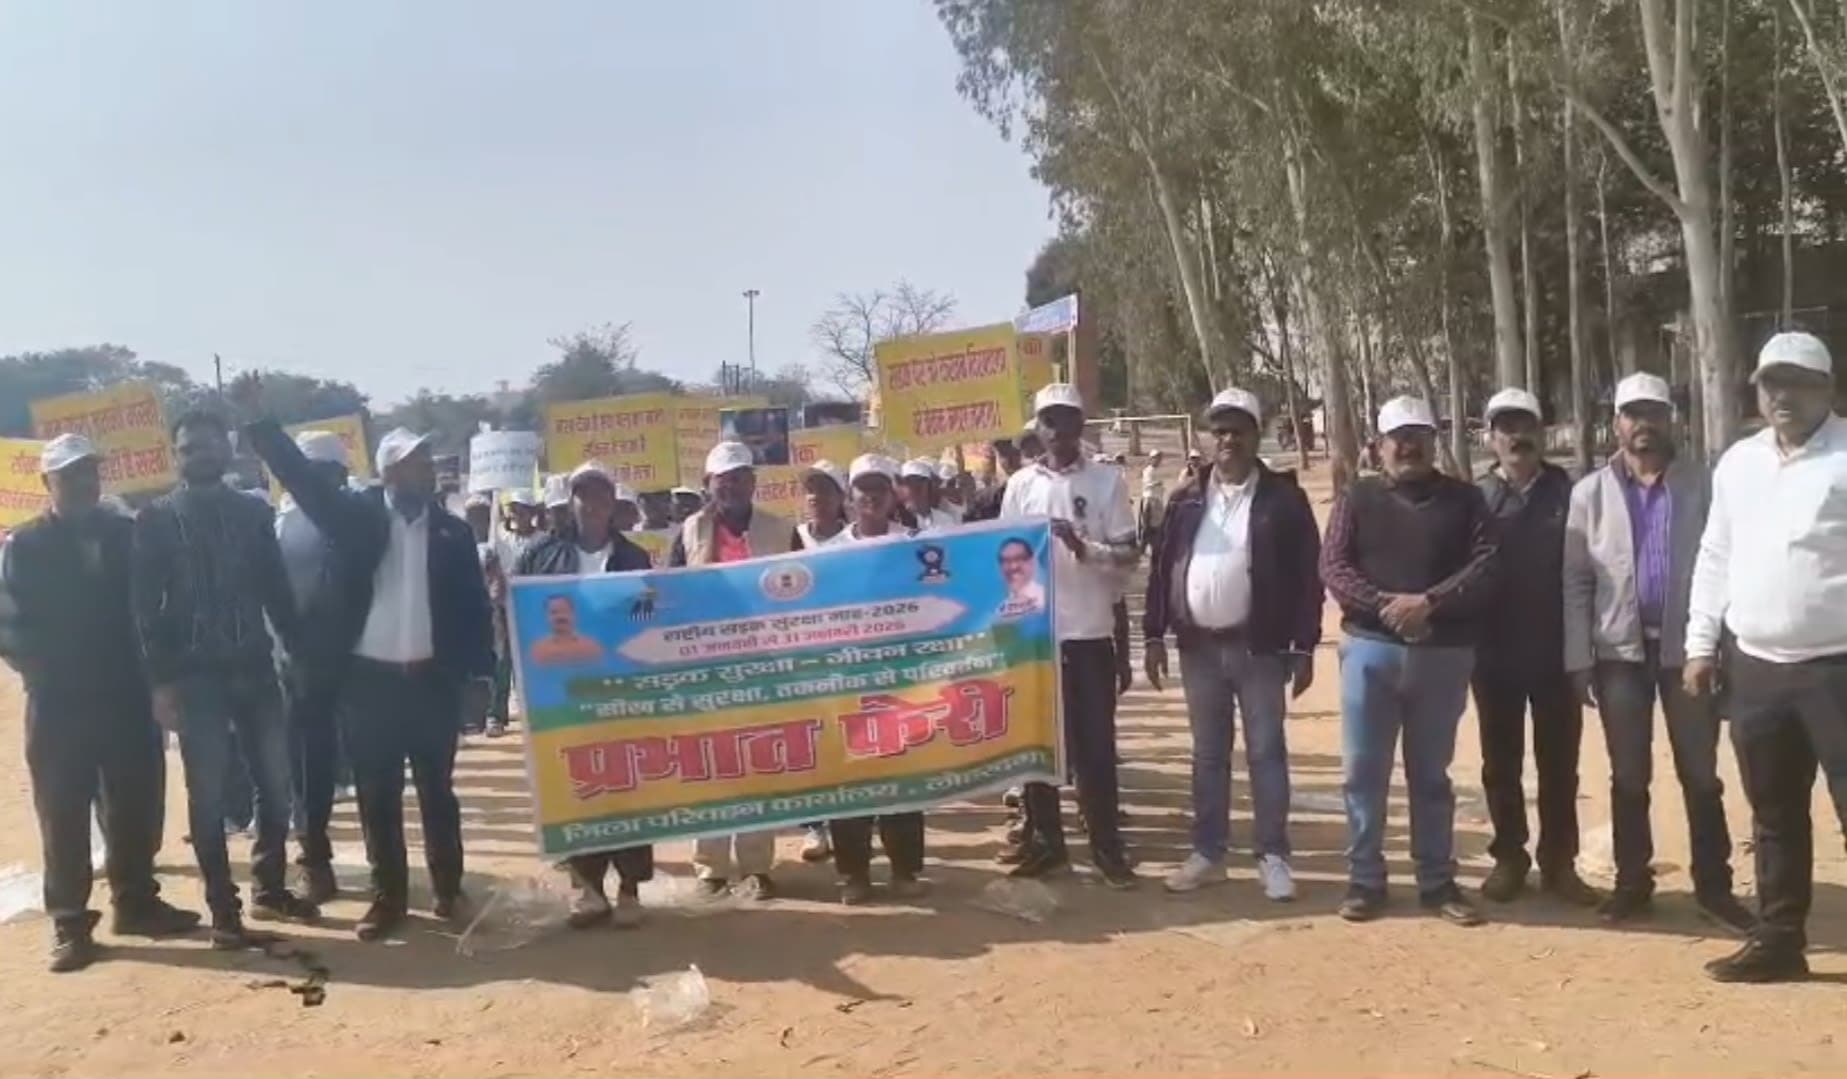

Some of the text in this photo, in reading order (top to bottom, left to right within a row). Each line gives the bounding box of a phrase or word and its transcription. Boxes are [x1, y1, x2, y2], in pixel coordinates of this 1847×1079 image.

[679, 645, 698, 657] 01
[783, 632, 799, 644] 31
[720, 619, 766, 637] सड़क
[772, 612, 824, 632] सुरक्षा
[632, 668, 708, 691] सड़क
[717, 658, 794, 684] सुरक्षा
[826, 642, 906, 665] जीवन
[659, 692, 685, 713] से
[776, 673, 867, 699] तकनीक
[872, 667, 896, 687] से
[561, 678, 1014, 800] प्रभात फेरी
[563, 813, 641, 843] जिला
[647, 798, 763, 828] परिवहन
[772, 783, 898, 812] कार्यालय
